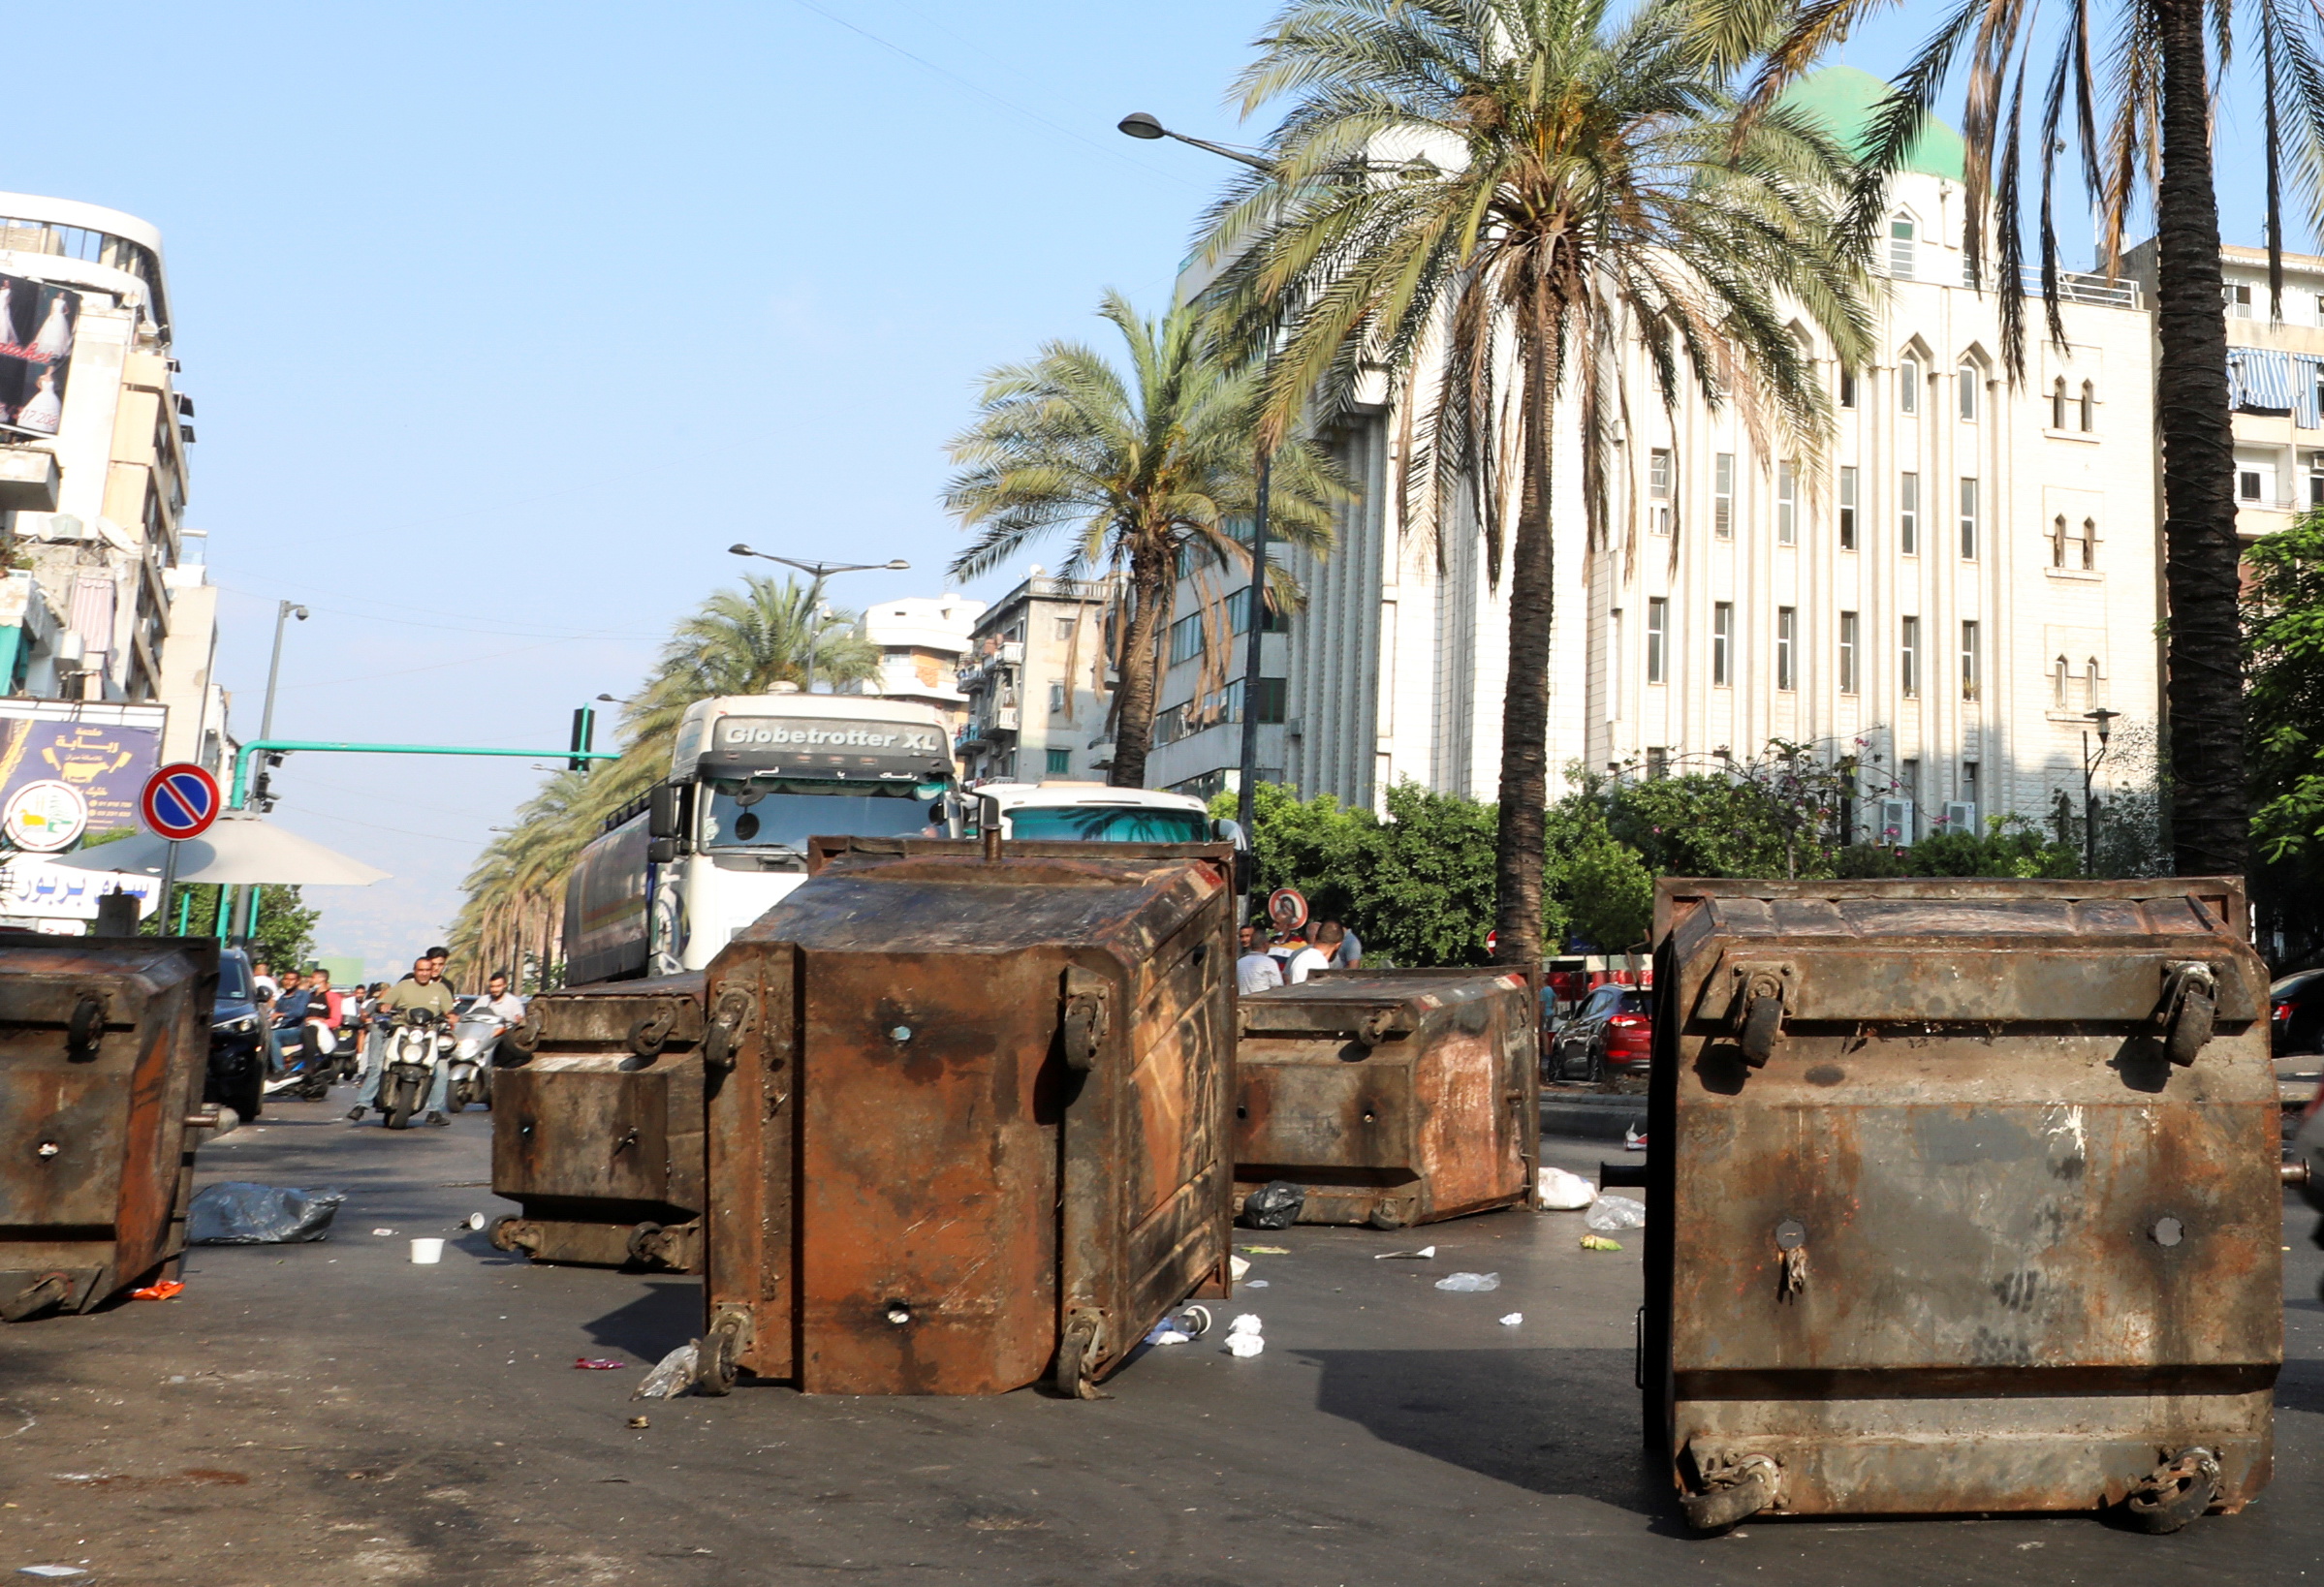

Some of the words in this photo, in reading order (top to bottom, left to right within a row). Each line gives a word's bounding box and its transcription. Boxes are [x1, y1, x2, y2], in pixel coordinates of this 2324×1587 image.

[725, 727, 897, 748] Globetrotter
[901, 732, 938, 752] XL
[94, 880, 149, 905] سق
